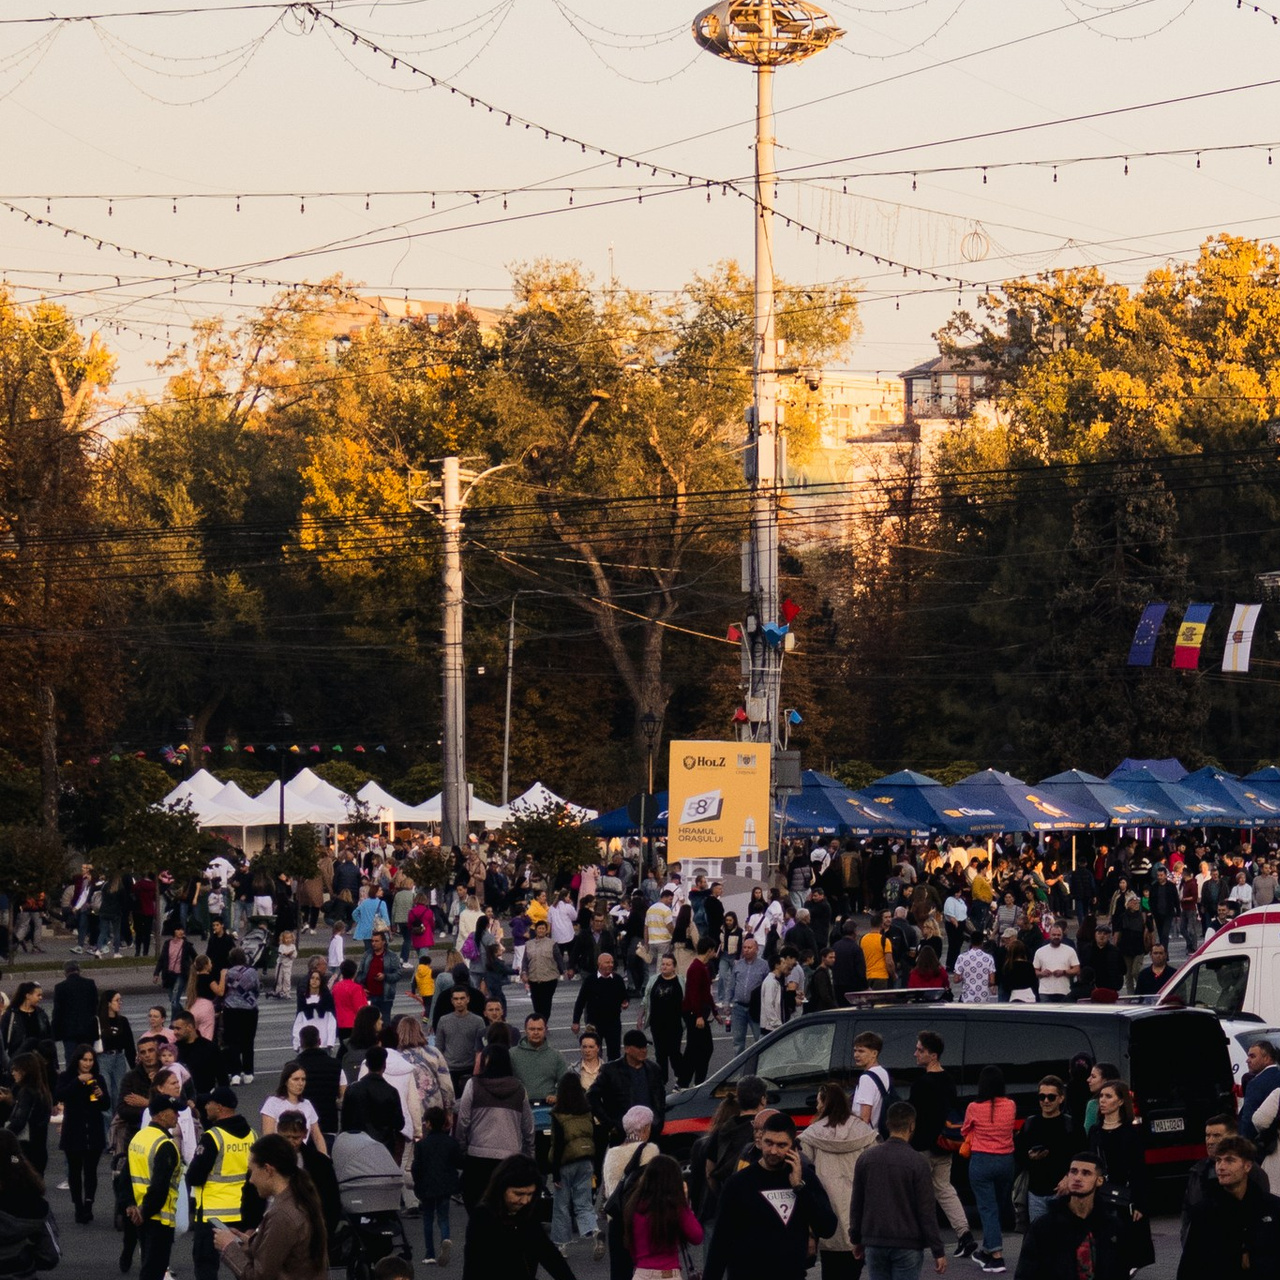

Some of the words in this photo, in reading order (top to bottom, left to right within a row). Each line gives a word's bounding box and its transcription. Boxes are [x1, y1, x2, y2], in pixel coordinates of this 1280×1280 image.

[686, 796, 716, 817] 587
[227, 1142, 253, 1153] POLIȚI
[767, 1192, 796, 1200] GUESS
